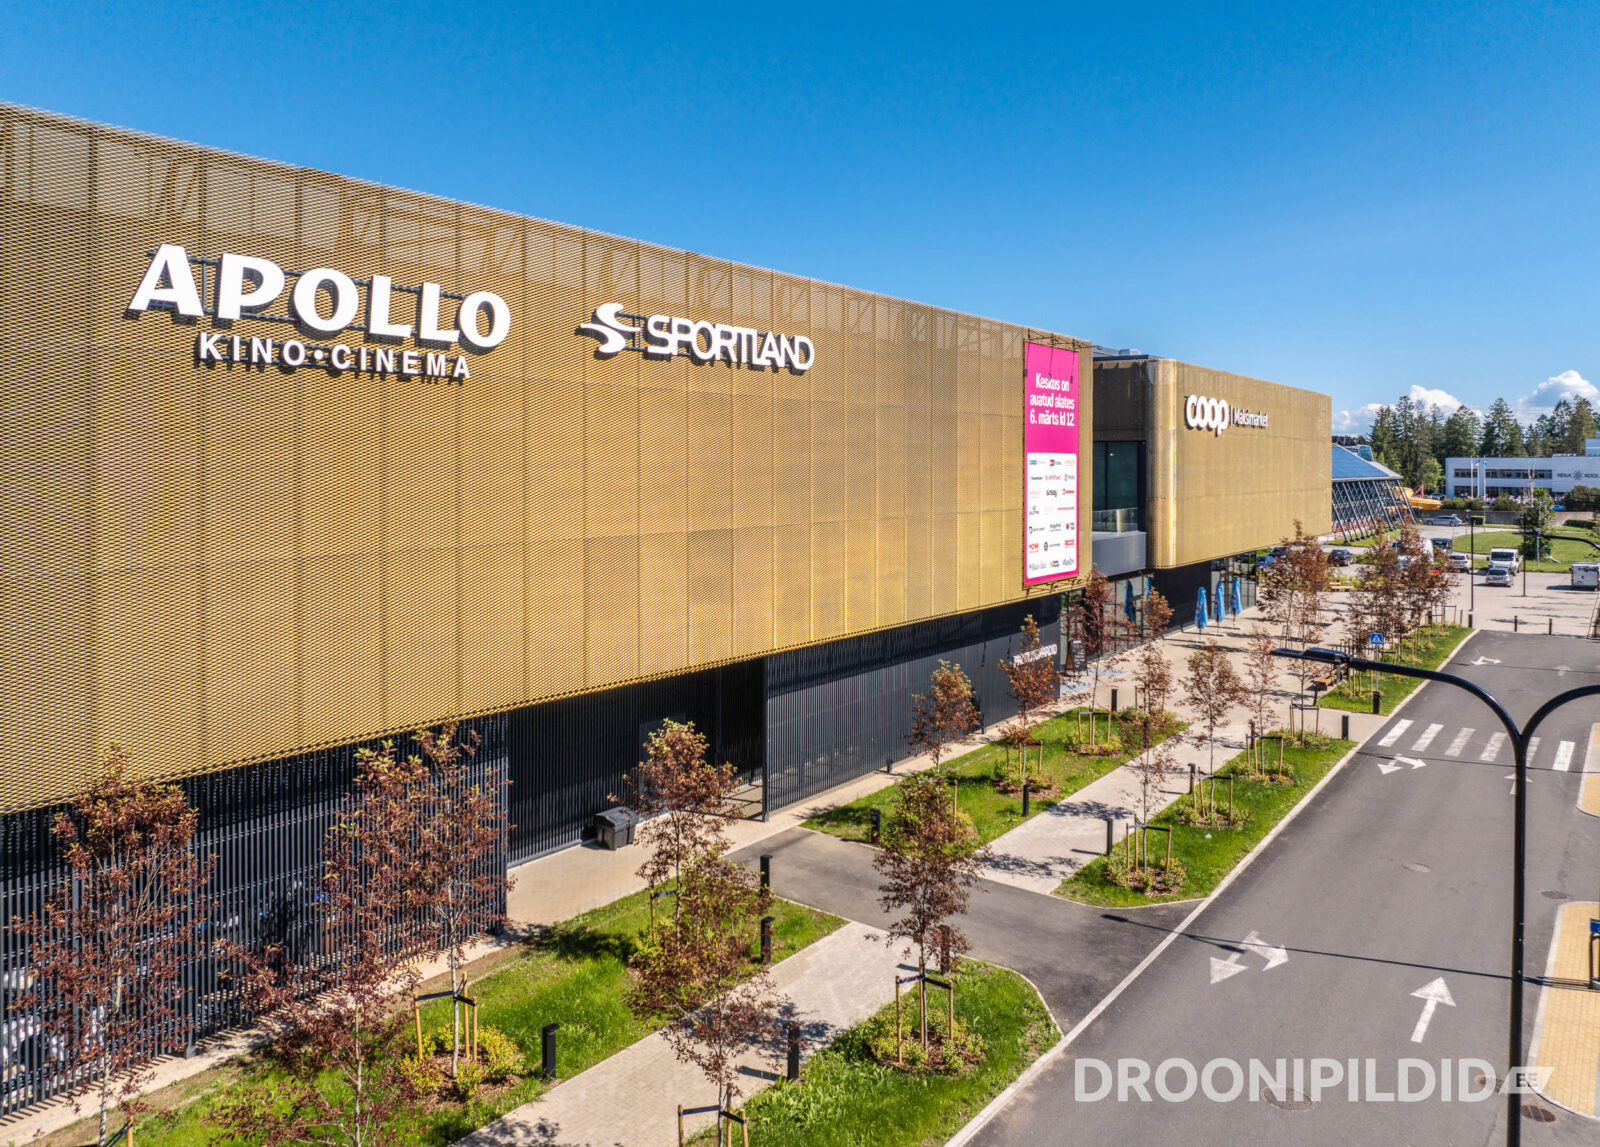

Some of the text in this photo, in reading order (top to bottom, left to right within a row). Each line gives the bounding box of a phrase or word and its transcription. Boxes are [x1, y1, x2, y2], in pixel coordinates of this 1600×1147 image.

[128, 243, 511, 347] APOLLO
[647, 314, 815, 370] SPORTLAND
[1035, 372, 1070, 392] Keskus on
[1029, 393, 1075, 410] avatud alates
[1029, 408, 1037, 425] 6.
[1038, 410, 1059, 425] märts
[1066, 412, 1075, 427] 12
